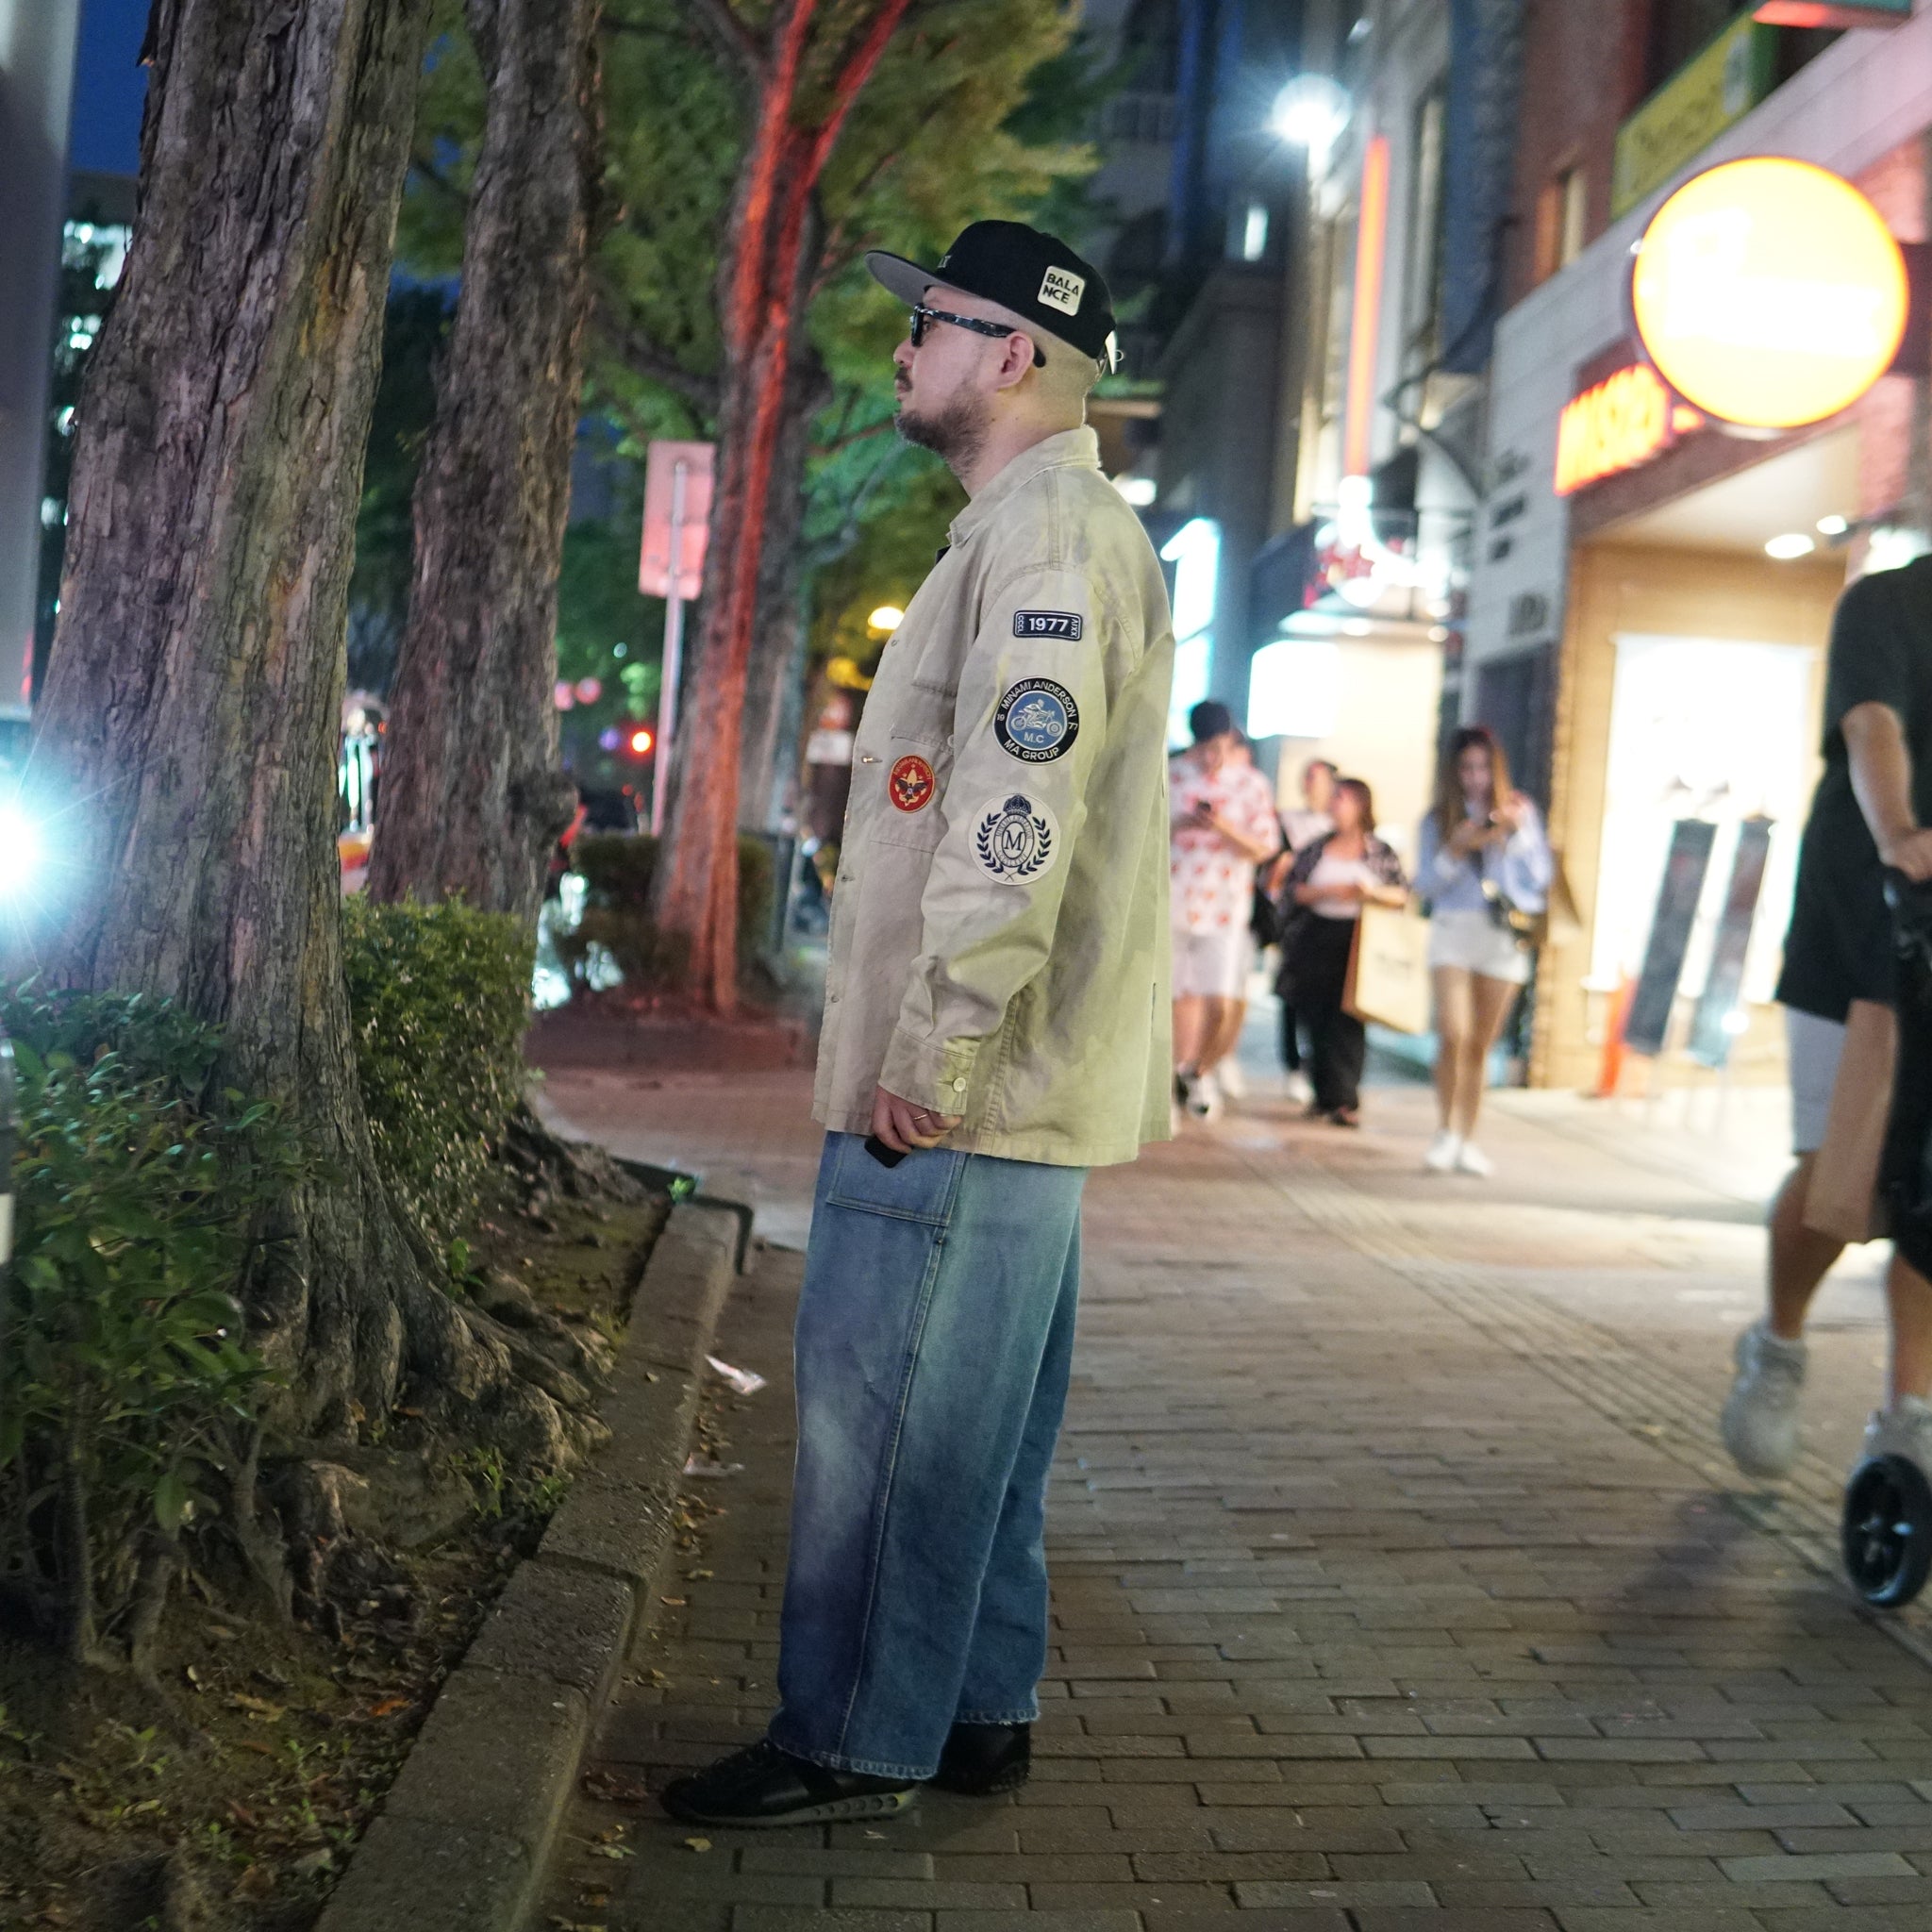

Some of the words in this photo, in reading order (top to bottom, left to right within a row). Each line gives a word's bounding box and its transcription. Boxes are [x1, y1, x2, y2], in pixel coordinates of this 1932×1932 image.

[1042, 284, 1070, 304] NCE
[1046, 273, 1079, 296] BALA
[1029, 618, 1068, 632] 1977
[1001, 681, 1031, 709] MINAMI
[1033, 681, 1077, 718] ANDERSON
[1004, 739, 1019, 755] MA
[1022, 747, 1059, 760] GROUP
[1004, 830, 1024, 851] M
